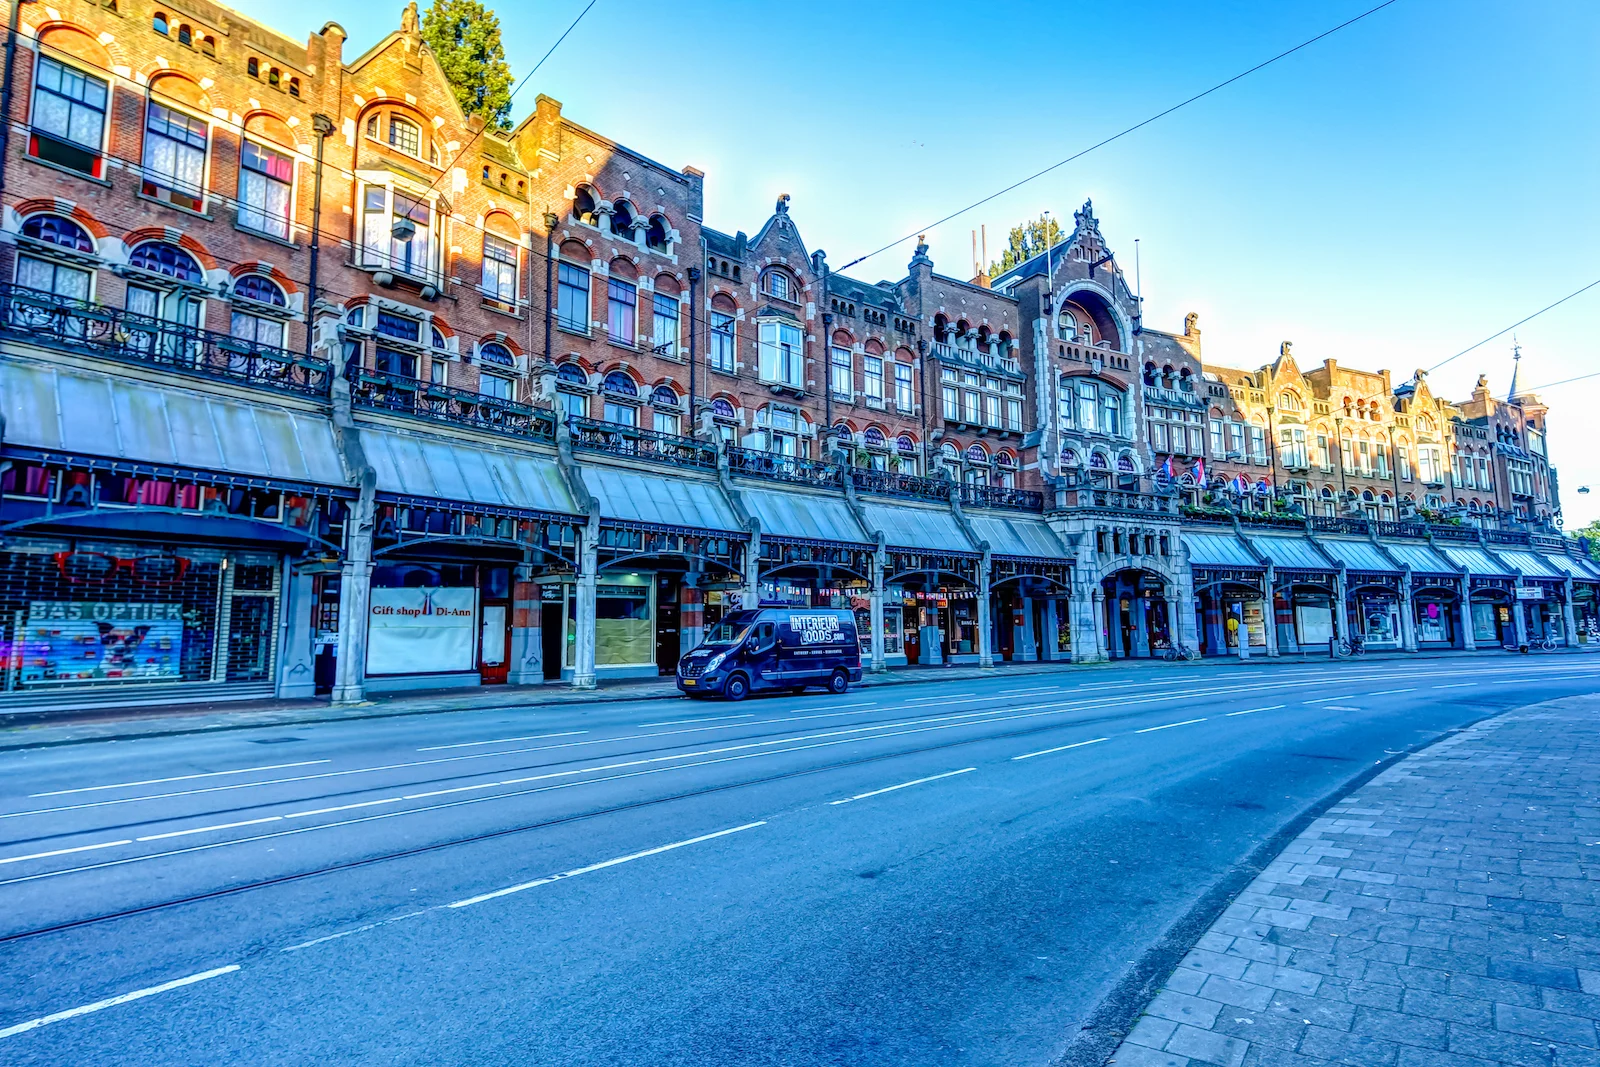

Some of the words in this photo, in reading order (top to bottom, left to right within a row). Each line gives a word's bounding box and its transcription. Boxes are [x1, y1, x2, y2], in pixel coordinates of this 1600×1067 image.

[30, 601, 83, 620] BAS
[93, 602, 183, 620] OPTIEK
[372, 605, 394, 615] Gift
[396, 606, 421, 618] shop
[435, 607, 471, 616] Di-Ann
[791, 616, 838, 630] INTERIEUR
